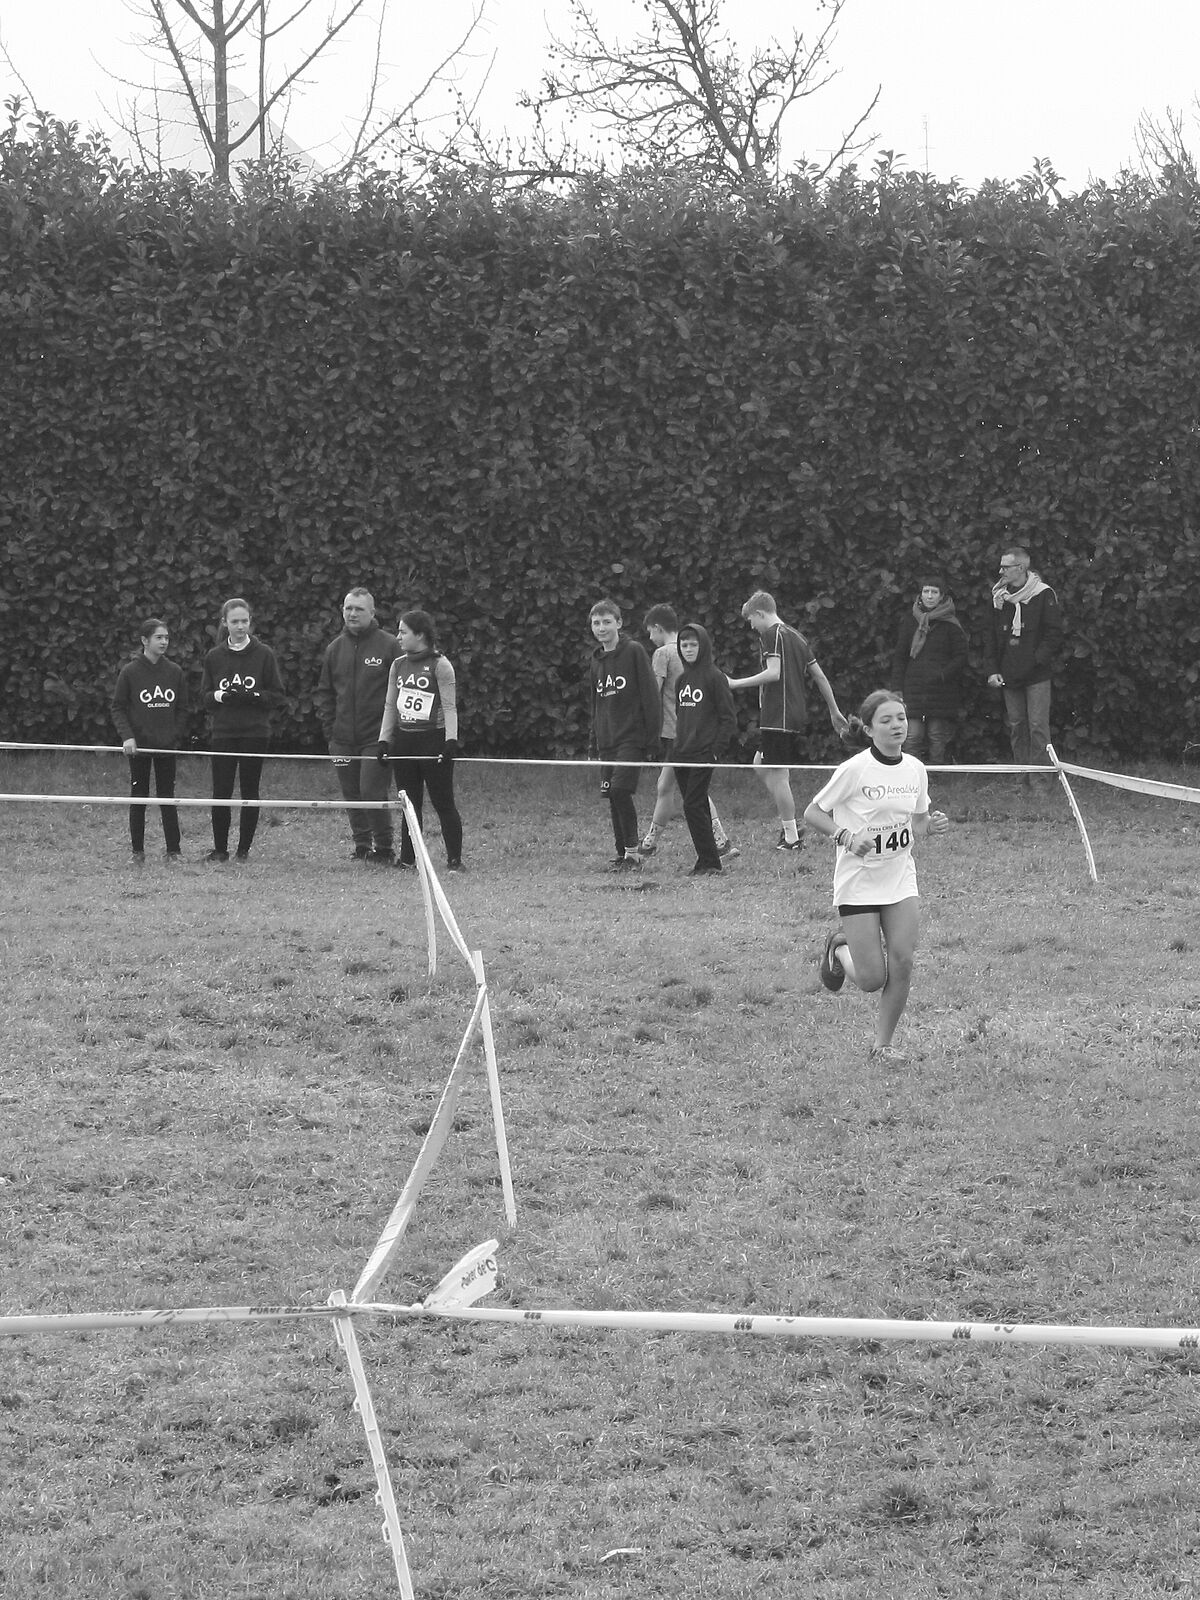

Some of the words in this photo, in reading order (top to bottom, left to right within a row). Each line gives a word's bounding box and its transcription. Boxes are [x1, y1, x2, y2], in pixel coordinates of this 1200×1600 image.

[140, 685, 176, 704] GAO
[403, 695, 424, 712] 56
[873, 828, 910, 855] 140
